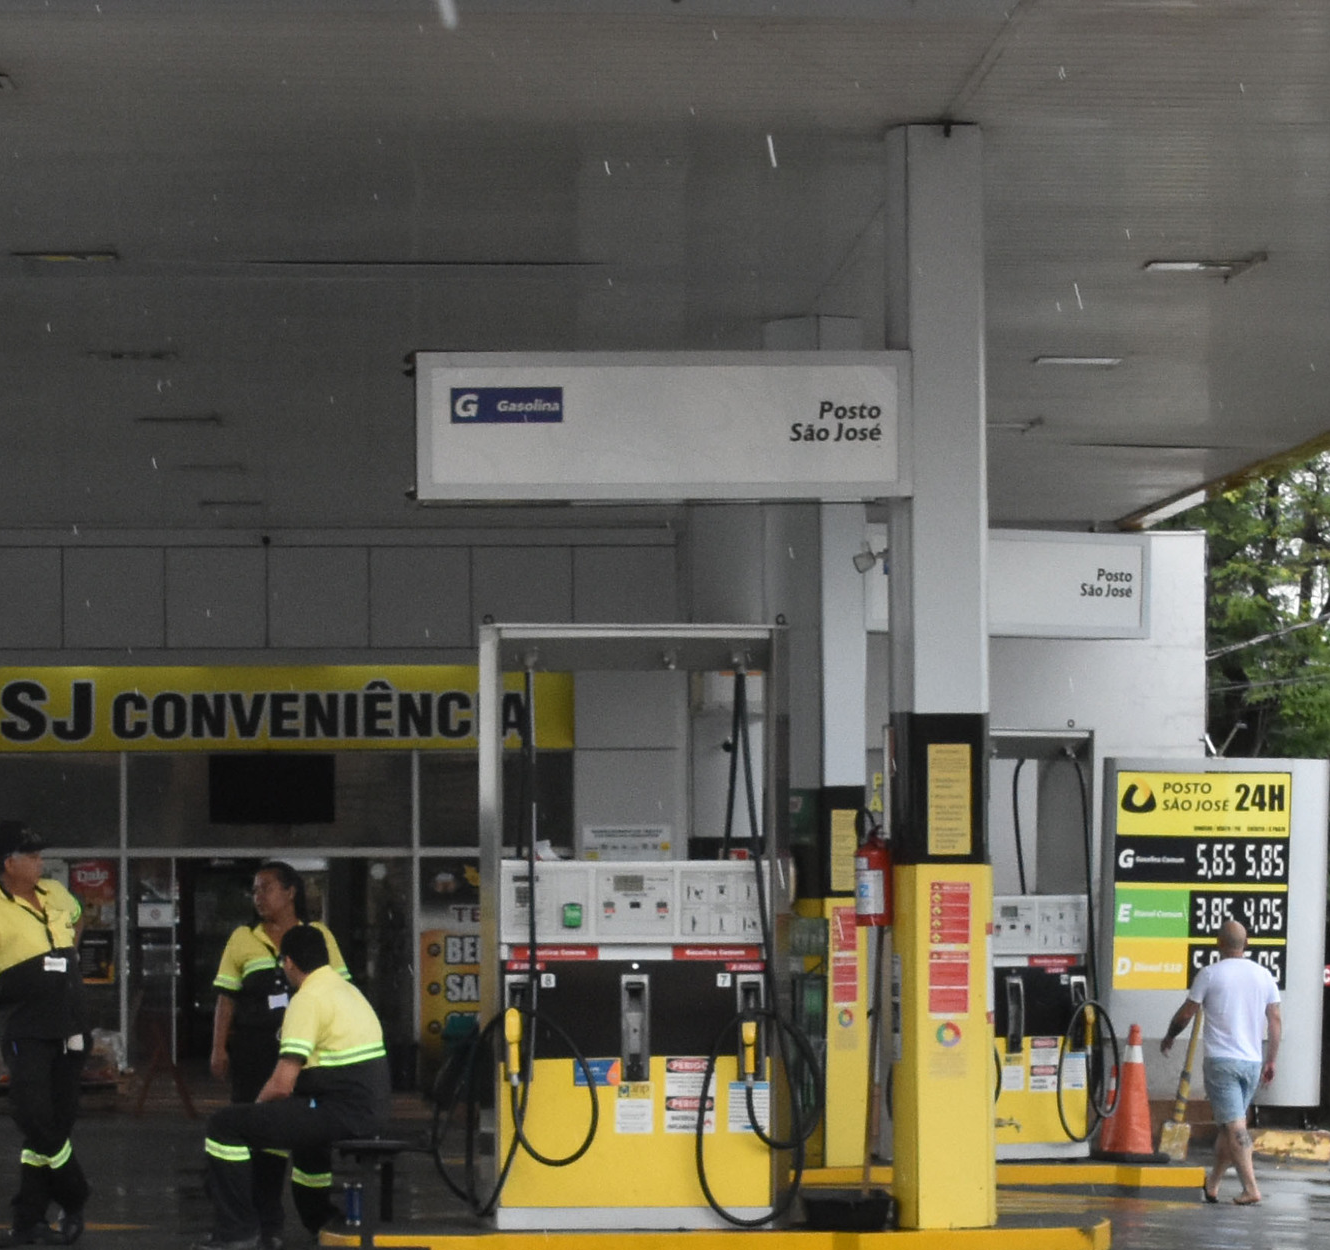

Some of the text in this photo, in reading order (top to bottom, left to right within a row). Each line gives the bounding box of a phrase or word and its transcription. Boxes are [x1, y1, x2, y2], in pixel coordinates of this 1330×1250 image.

[455, 393, 560, 417] G Gasolina
[819, 401, 881, 419] Posto
[790, 422, 882, 442] São José
[1097, 568, 1133, 582] Posto
[1080, 583, 1133, 598] São José
[0, 679, 530, 741] SJ CONVENIÊNCA
[1162, 797, 1229, 812] SÃO JOSÉ
[1163, 782, 1285, 812] POSTO 24H
[1119, 849, 1135, 868] G
[1196, 844, 1236, 879] 5,65
[1245, 844, 1284, 879] 5,85
[1118, 903, 1133, 923] E
[1116, 957, 1132, 976] D
[720, 975, 728, 986] 7
